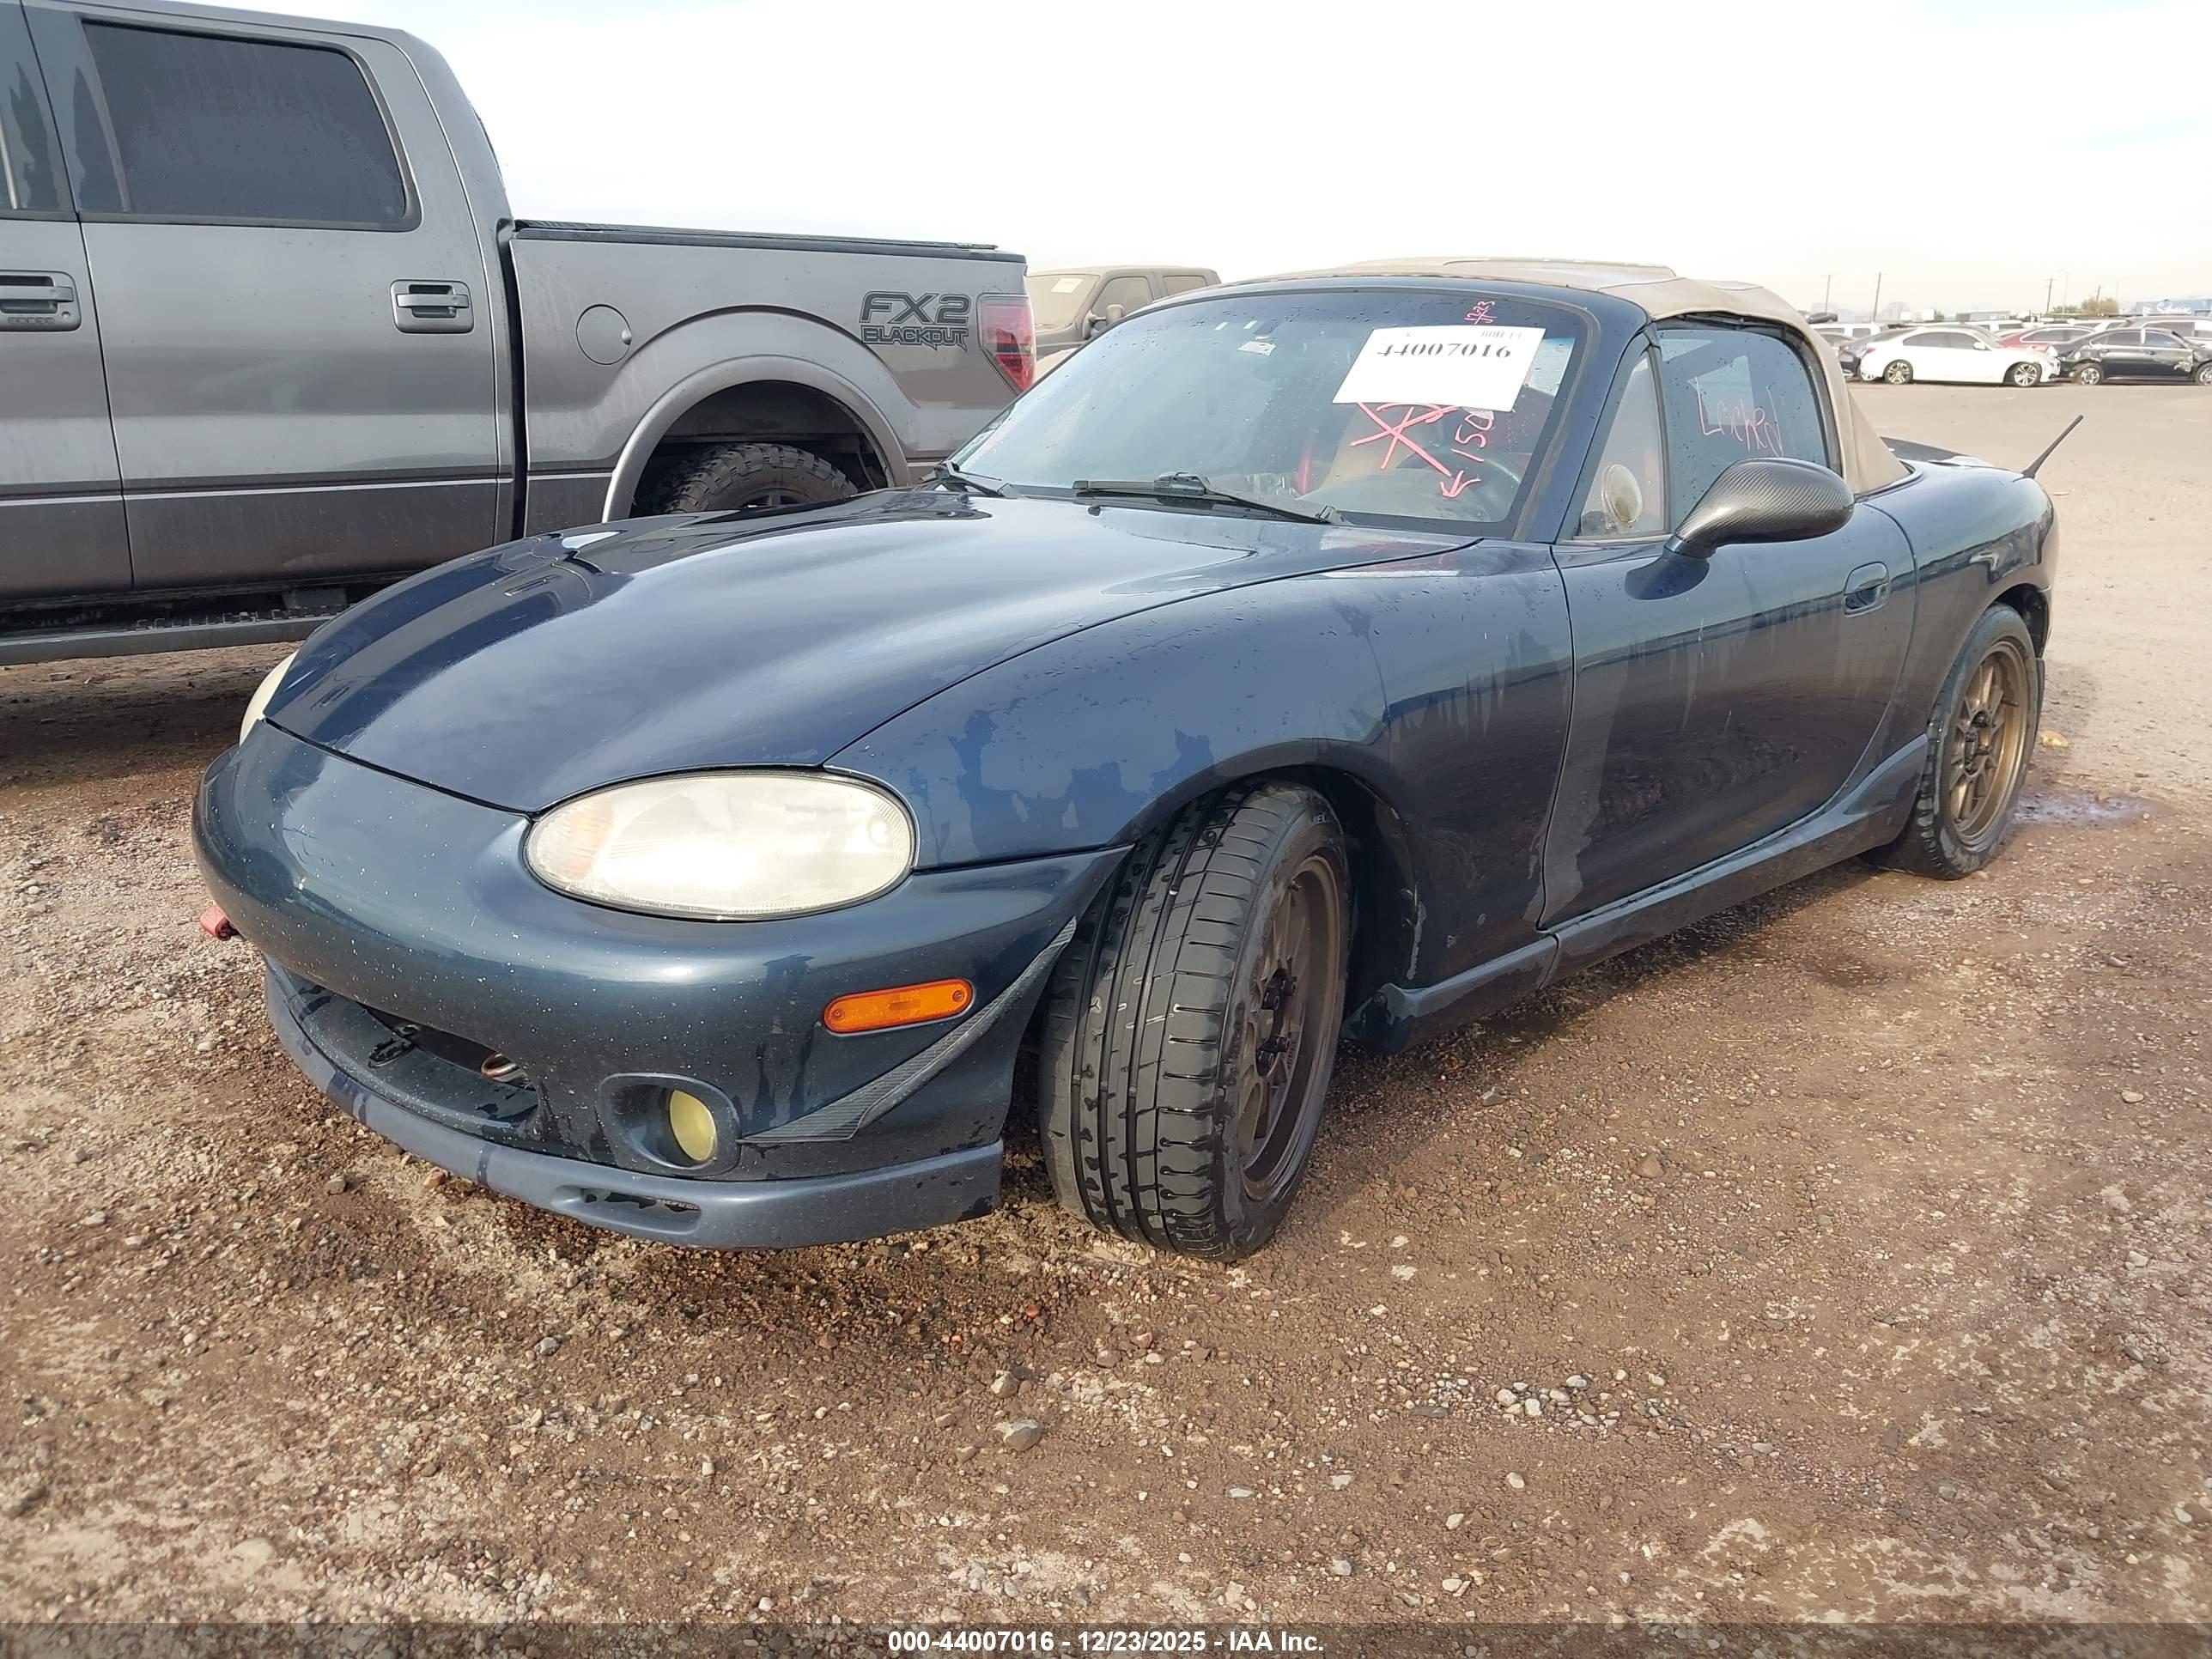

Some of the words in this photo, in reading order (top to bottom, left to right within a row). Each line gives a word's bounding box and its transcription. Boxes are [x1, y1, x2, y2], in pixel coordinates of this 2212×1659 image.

[859, 291, 971, 325] FX2
[861, 325, 969, 350] BLACKOUT
[1377, 343, 1511, 358] 44007016
